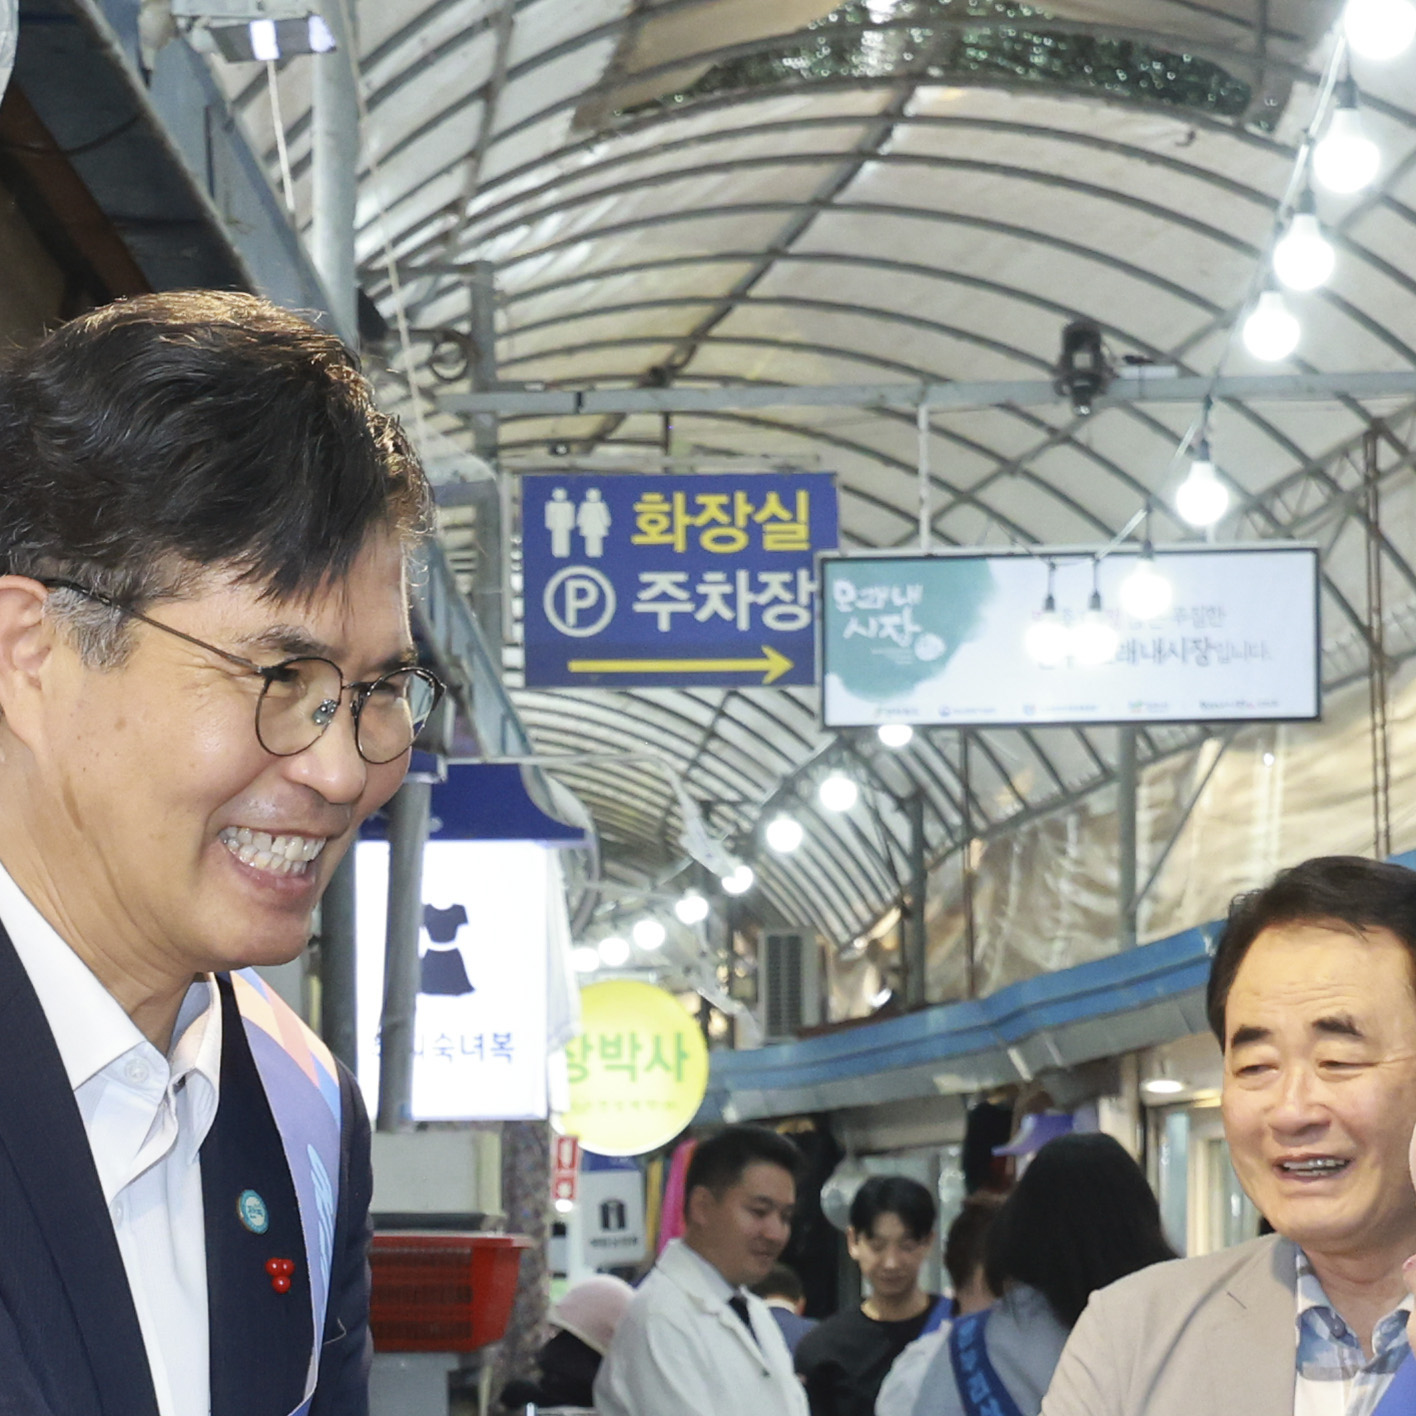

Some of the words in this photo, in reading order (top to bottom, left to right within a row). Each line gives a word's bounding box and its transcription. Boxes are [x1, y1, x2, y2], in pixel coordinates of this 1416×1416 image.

[631, 491, 810, 553] 화장실
[633, 568, 819, 631] 주차장
[843, 606, 922, 648] 시장
